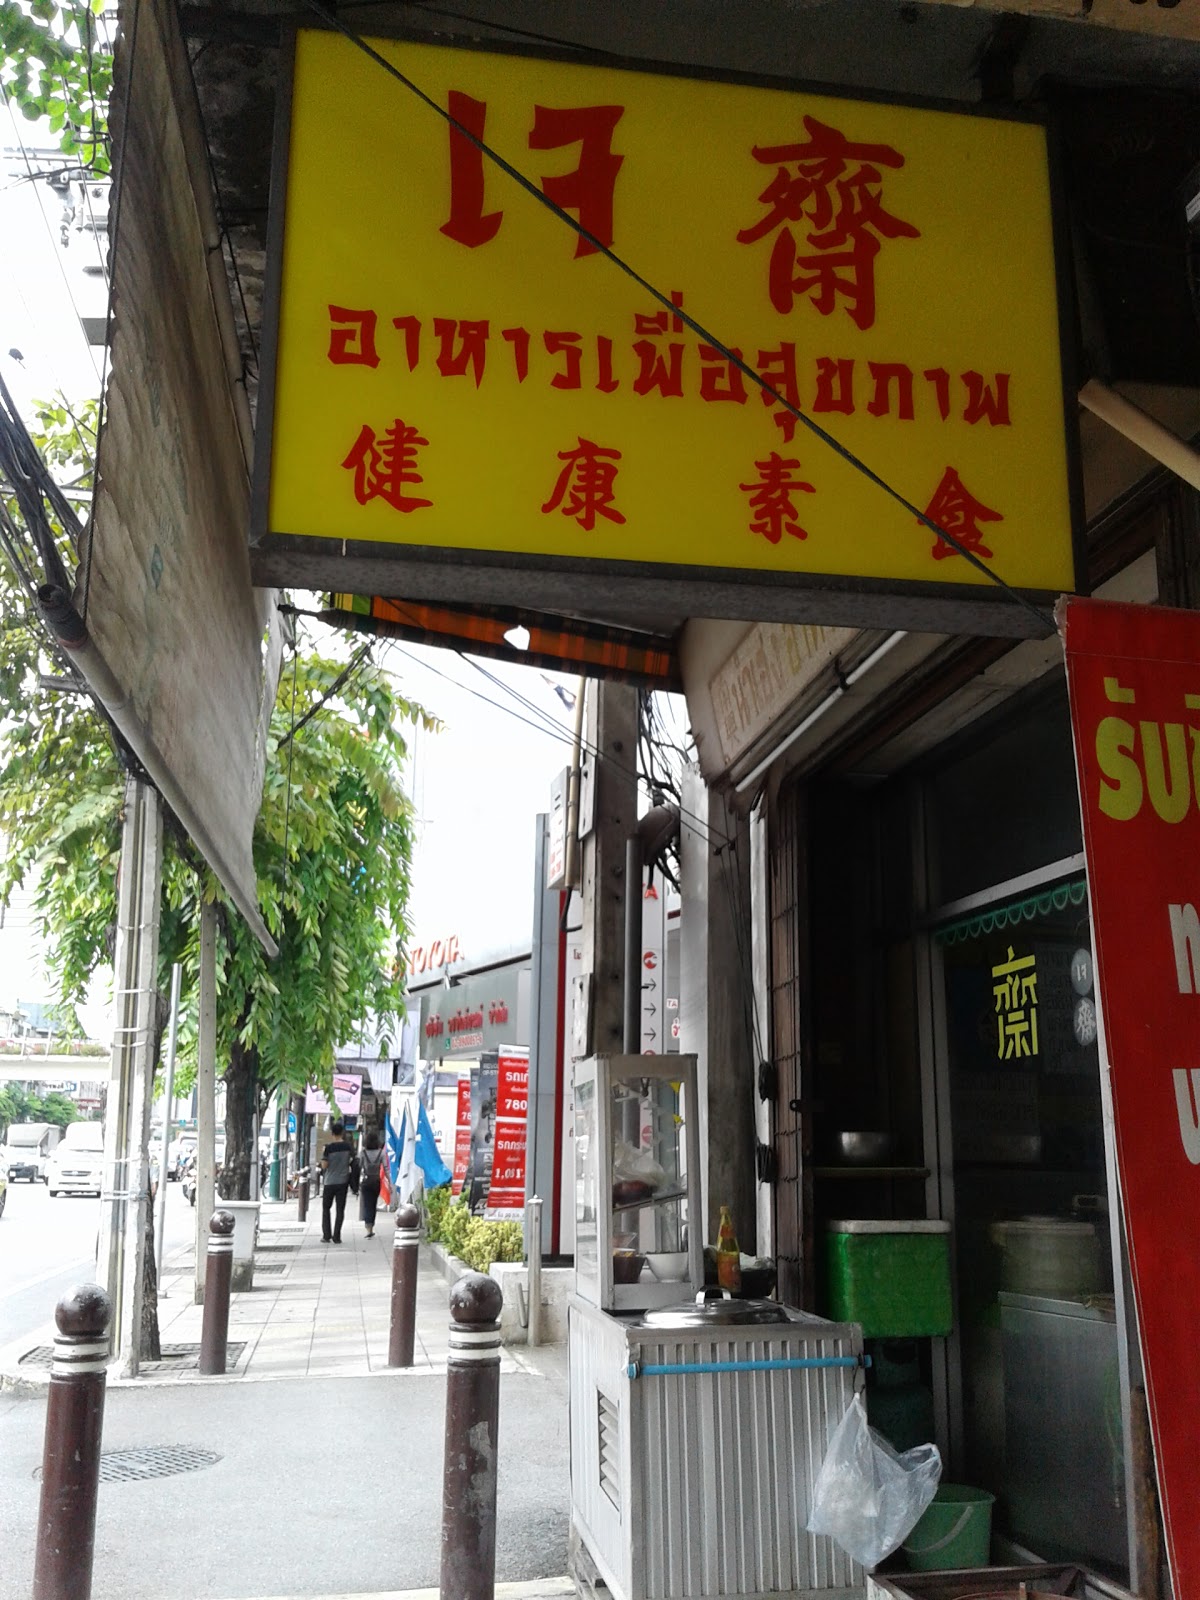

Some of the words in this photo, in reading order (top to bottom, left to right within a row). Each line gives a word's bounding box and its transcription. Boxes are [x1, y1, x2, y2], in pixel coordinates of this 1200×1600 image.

[439, 90, 625, 259] เจ
[327, 291, 1011, 444] อาหารเพื่อสุขภาพ
